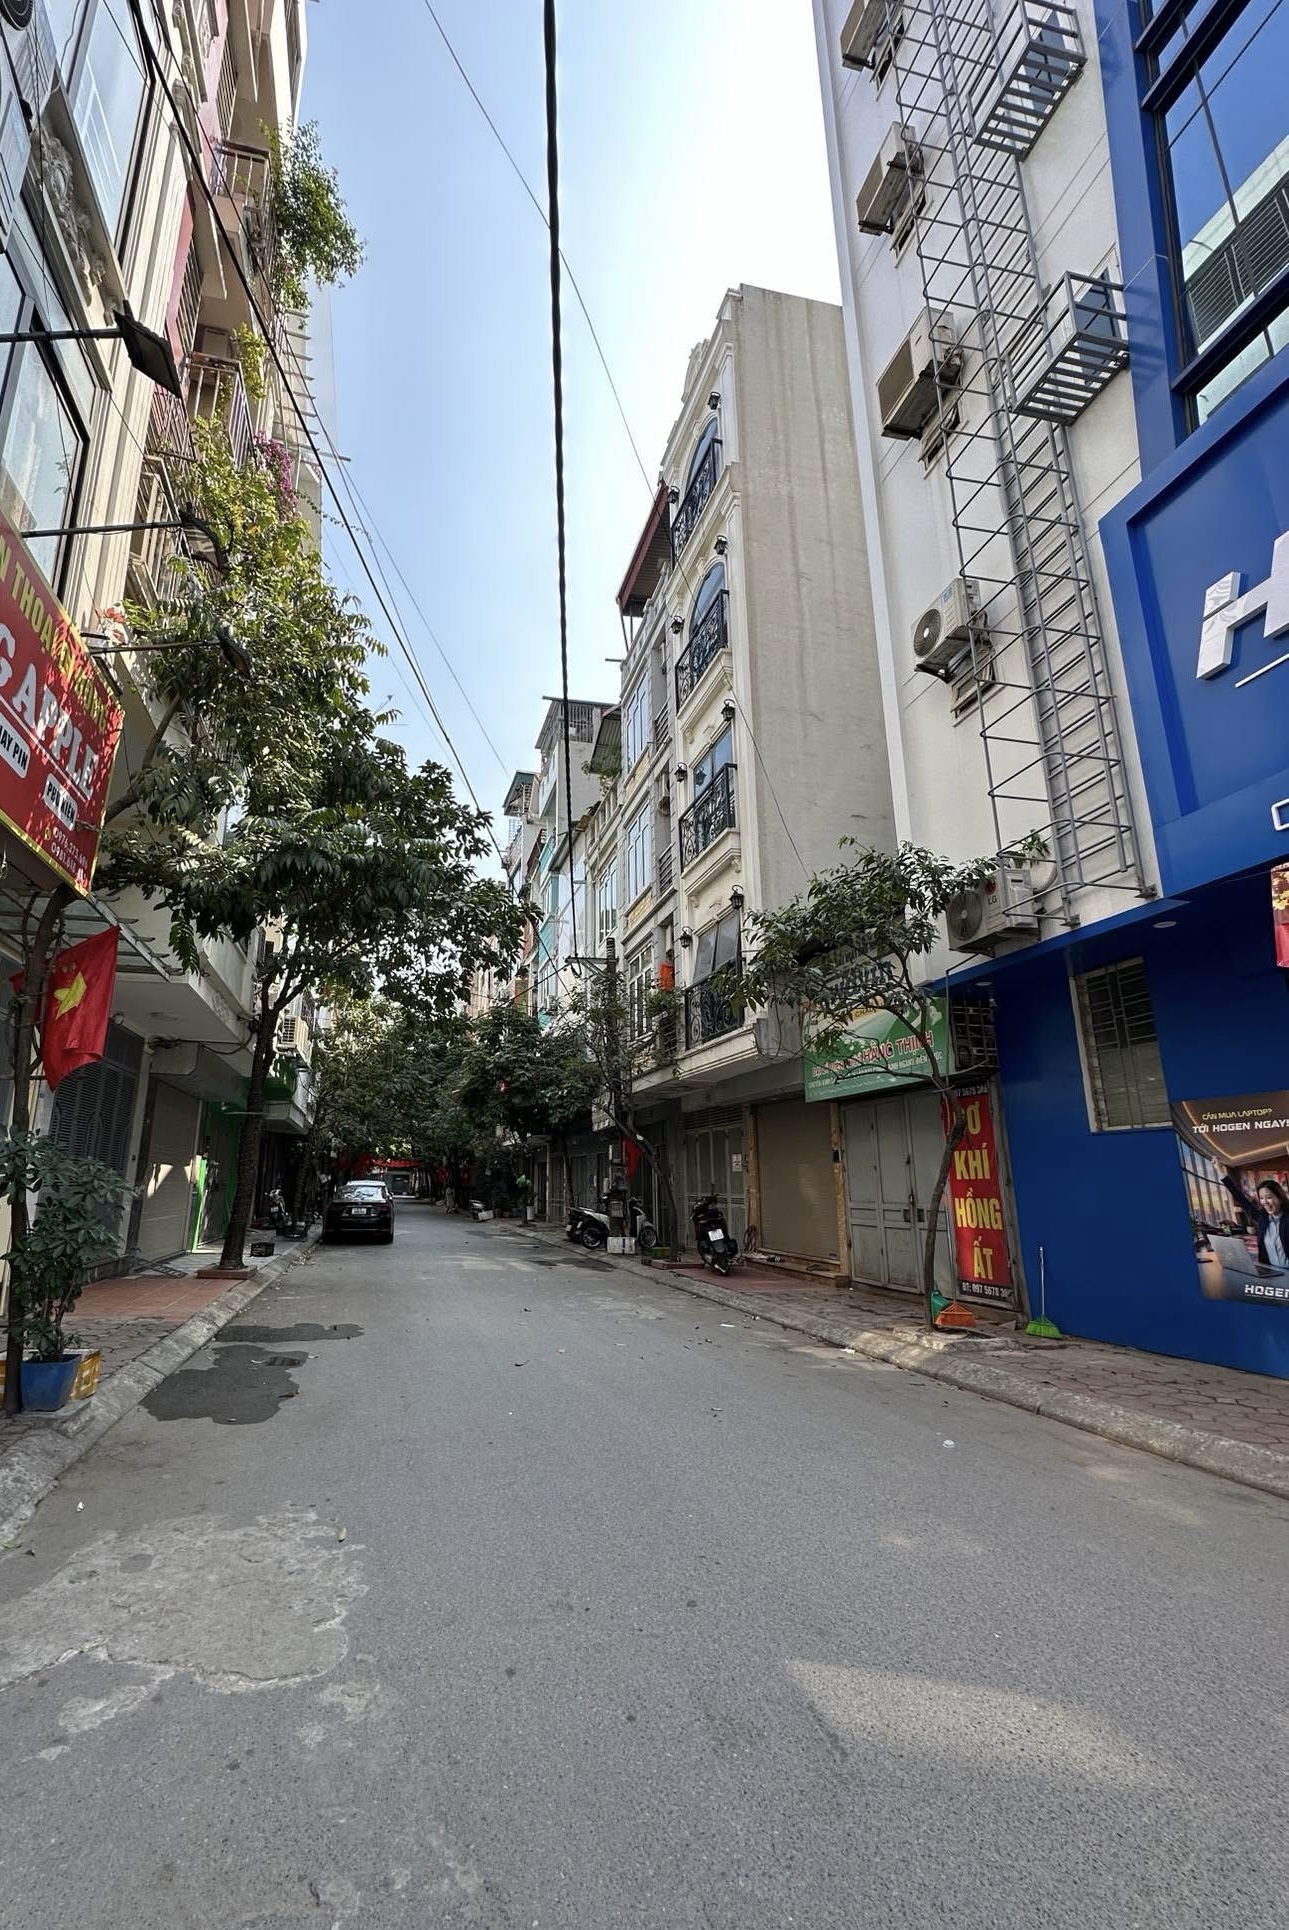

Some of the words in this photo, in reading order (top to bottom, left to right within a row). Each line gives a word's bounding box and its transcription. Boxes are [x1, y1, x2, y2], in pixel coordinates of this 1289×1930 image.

[12, 663, 99, 802] APPLE
[12, 742, 28, 770] PIN
[988, 895, 997, 905] LG
[1192, 1123, 1209, 1134] TỚI
[1212, 1121, 1251, 1132] HOGEN
[1218, 1111, 1237, 1119] MUA
[953, 1142, 991, 1180] KHÍ
[954, 1187, 1004, 1231] HỒNG
[973, 1235, 993, 1280] ẤT
